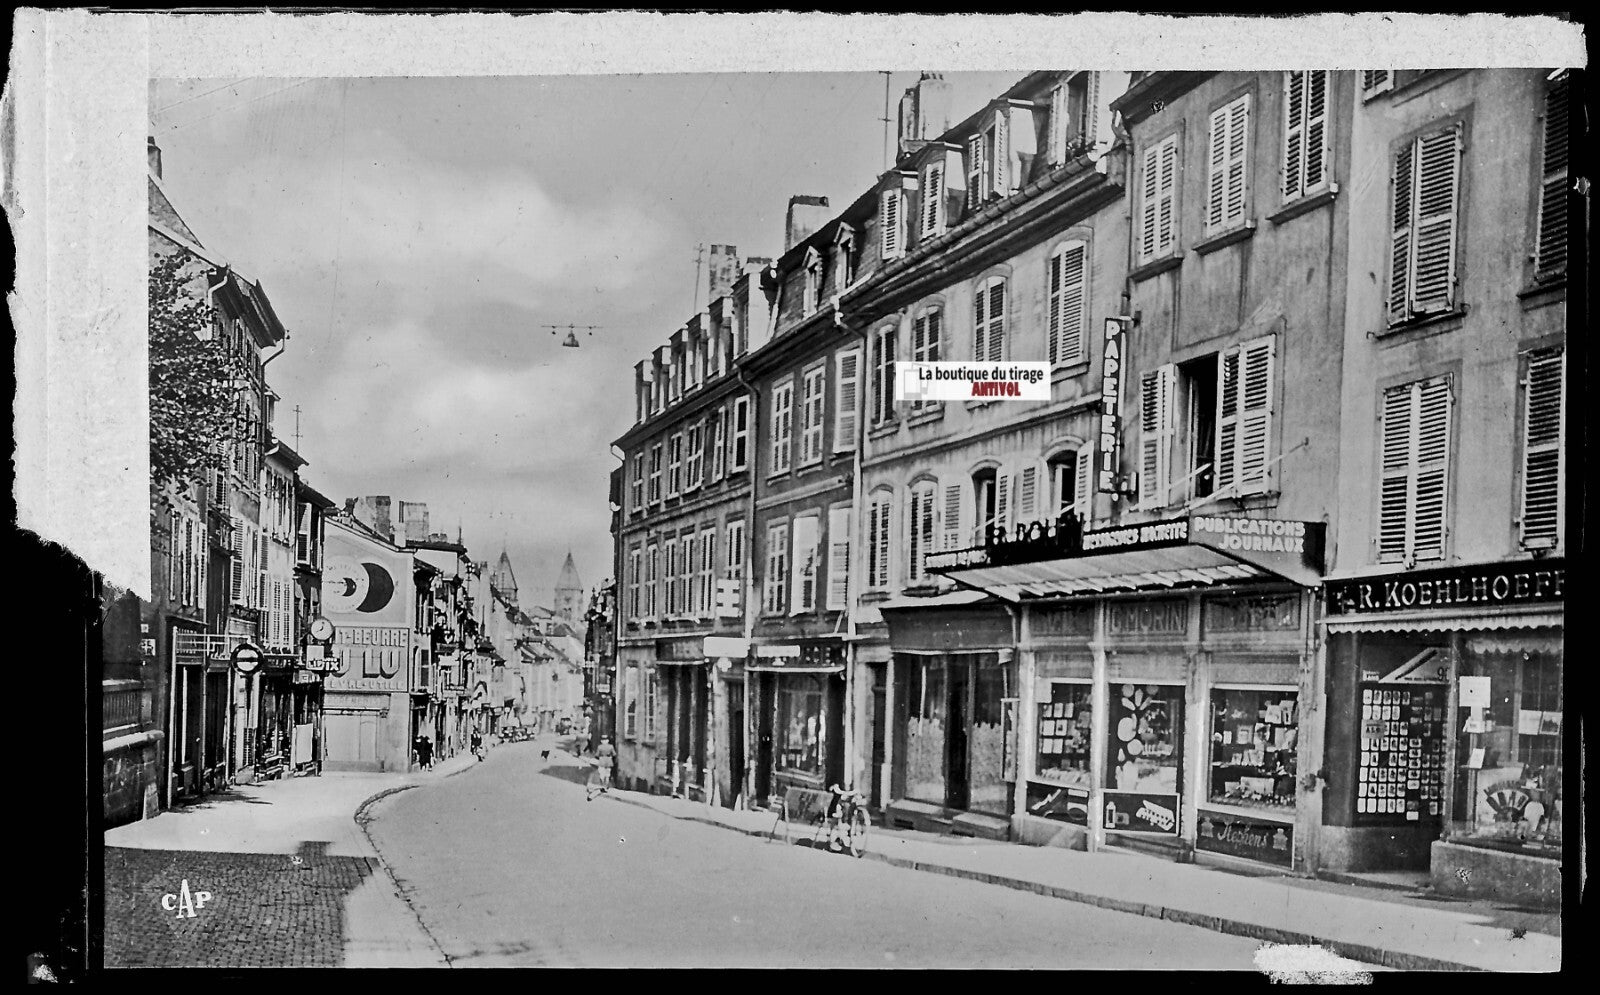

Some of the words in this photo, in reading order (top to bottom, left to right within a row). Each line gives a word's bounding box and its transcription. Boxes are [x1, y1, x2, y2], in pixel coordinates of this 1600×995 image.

[1100, 320, 1121, 490] PAPETERIE
[1193, 516, 1306, 538] PUBLICATIONS
[1217, 533, 1305, 553] JOURNAUX
[362, 648, 401, 679] LU
